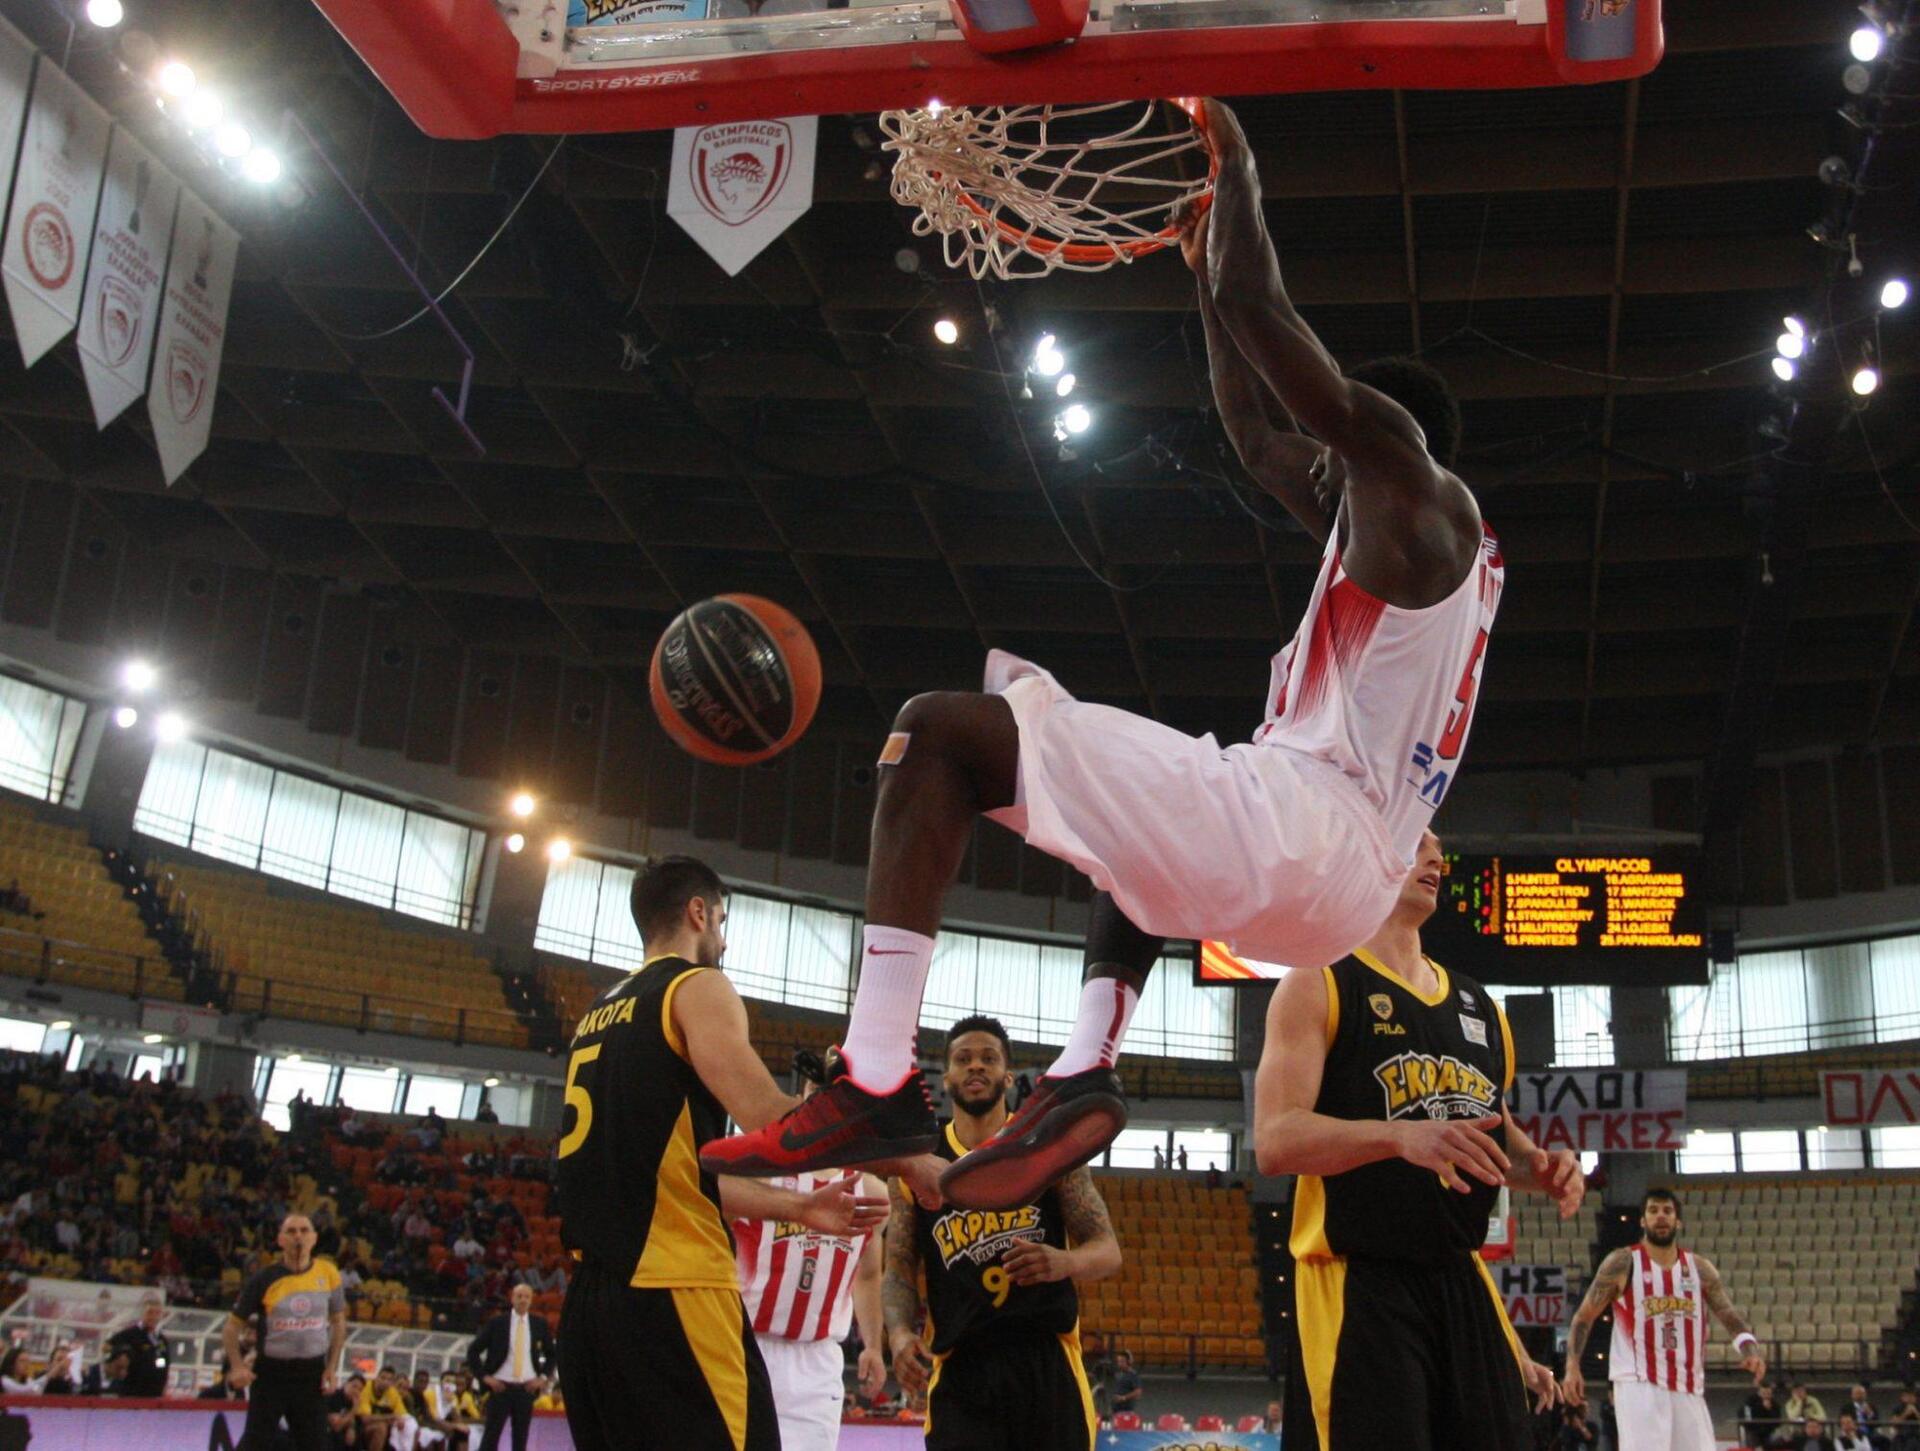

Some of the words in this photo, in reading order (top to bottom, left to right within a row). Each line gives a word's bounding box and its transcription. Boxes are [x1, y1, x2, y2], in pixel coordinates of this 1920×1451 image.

[703, 124, 783, 142] OLYMPIACOS
[712, 135, 771, 149] BASKETBALL
[1556, 859, 1651, 872] OLYMPIACOS
[1373, 1023, 1406, 1035] FILA
[558, 1043, 602, 1160] 5
[800, 1257, 816, 1292] 6
[982, 1266, 1010, 1308] 9
